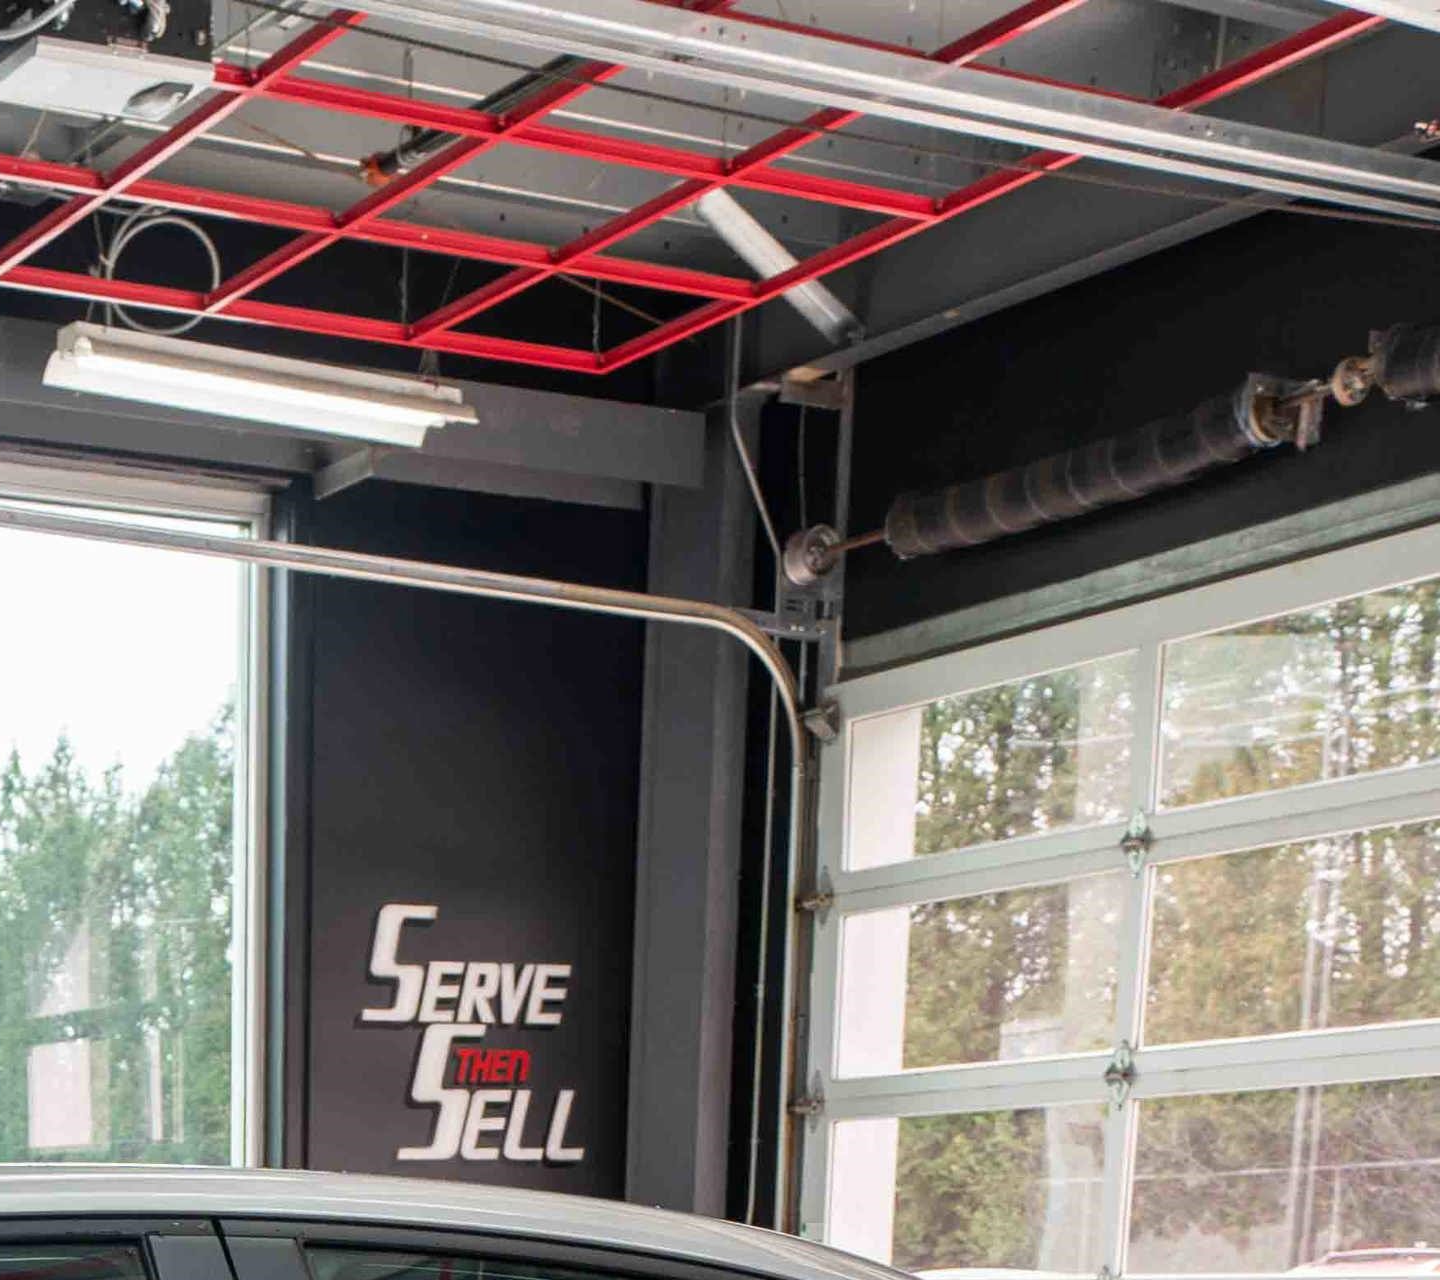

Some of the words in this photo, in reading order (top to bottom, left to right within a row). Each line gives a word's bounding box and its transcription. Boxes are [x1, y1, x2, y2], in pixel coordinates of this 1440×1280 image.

[361, 903, 572, 1026] SERVE
[396, 1023, 585, 1162] SELL
[455, 1048, 532, 1084] THEN
